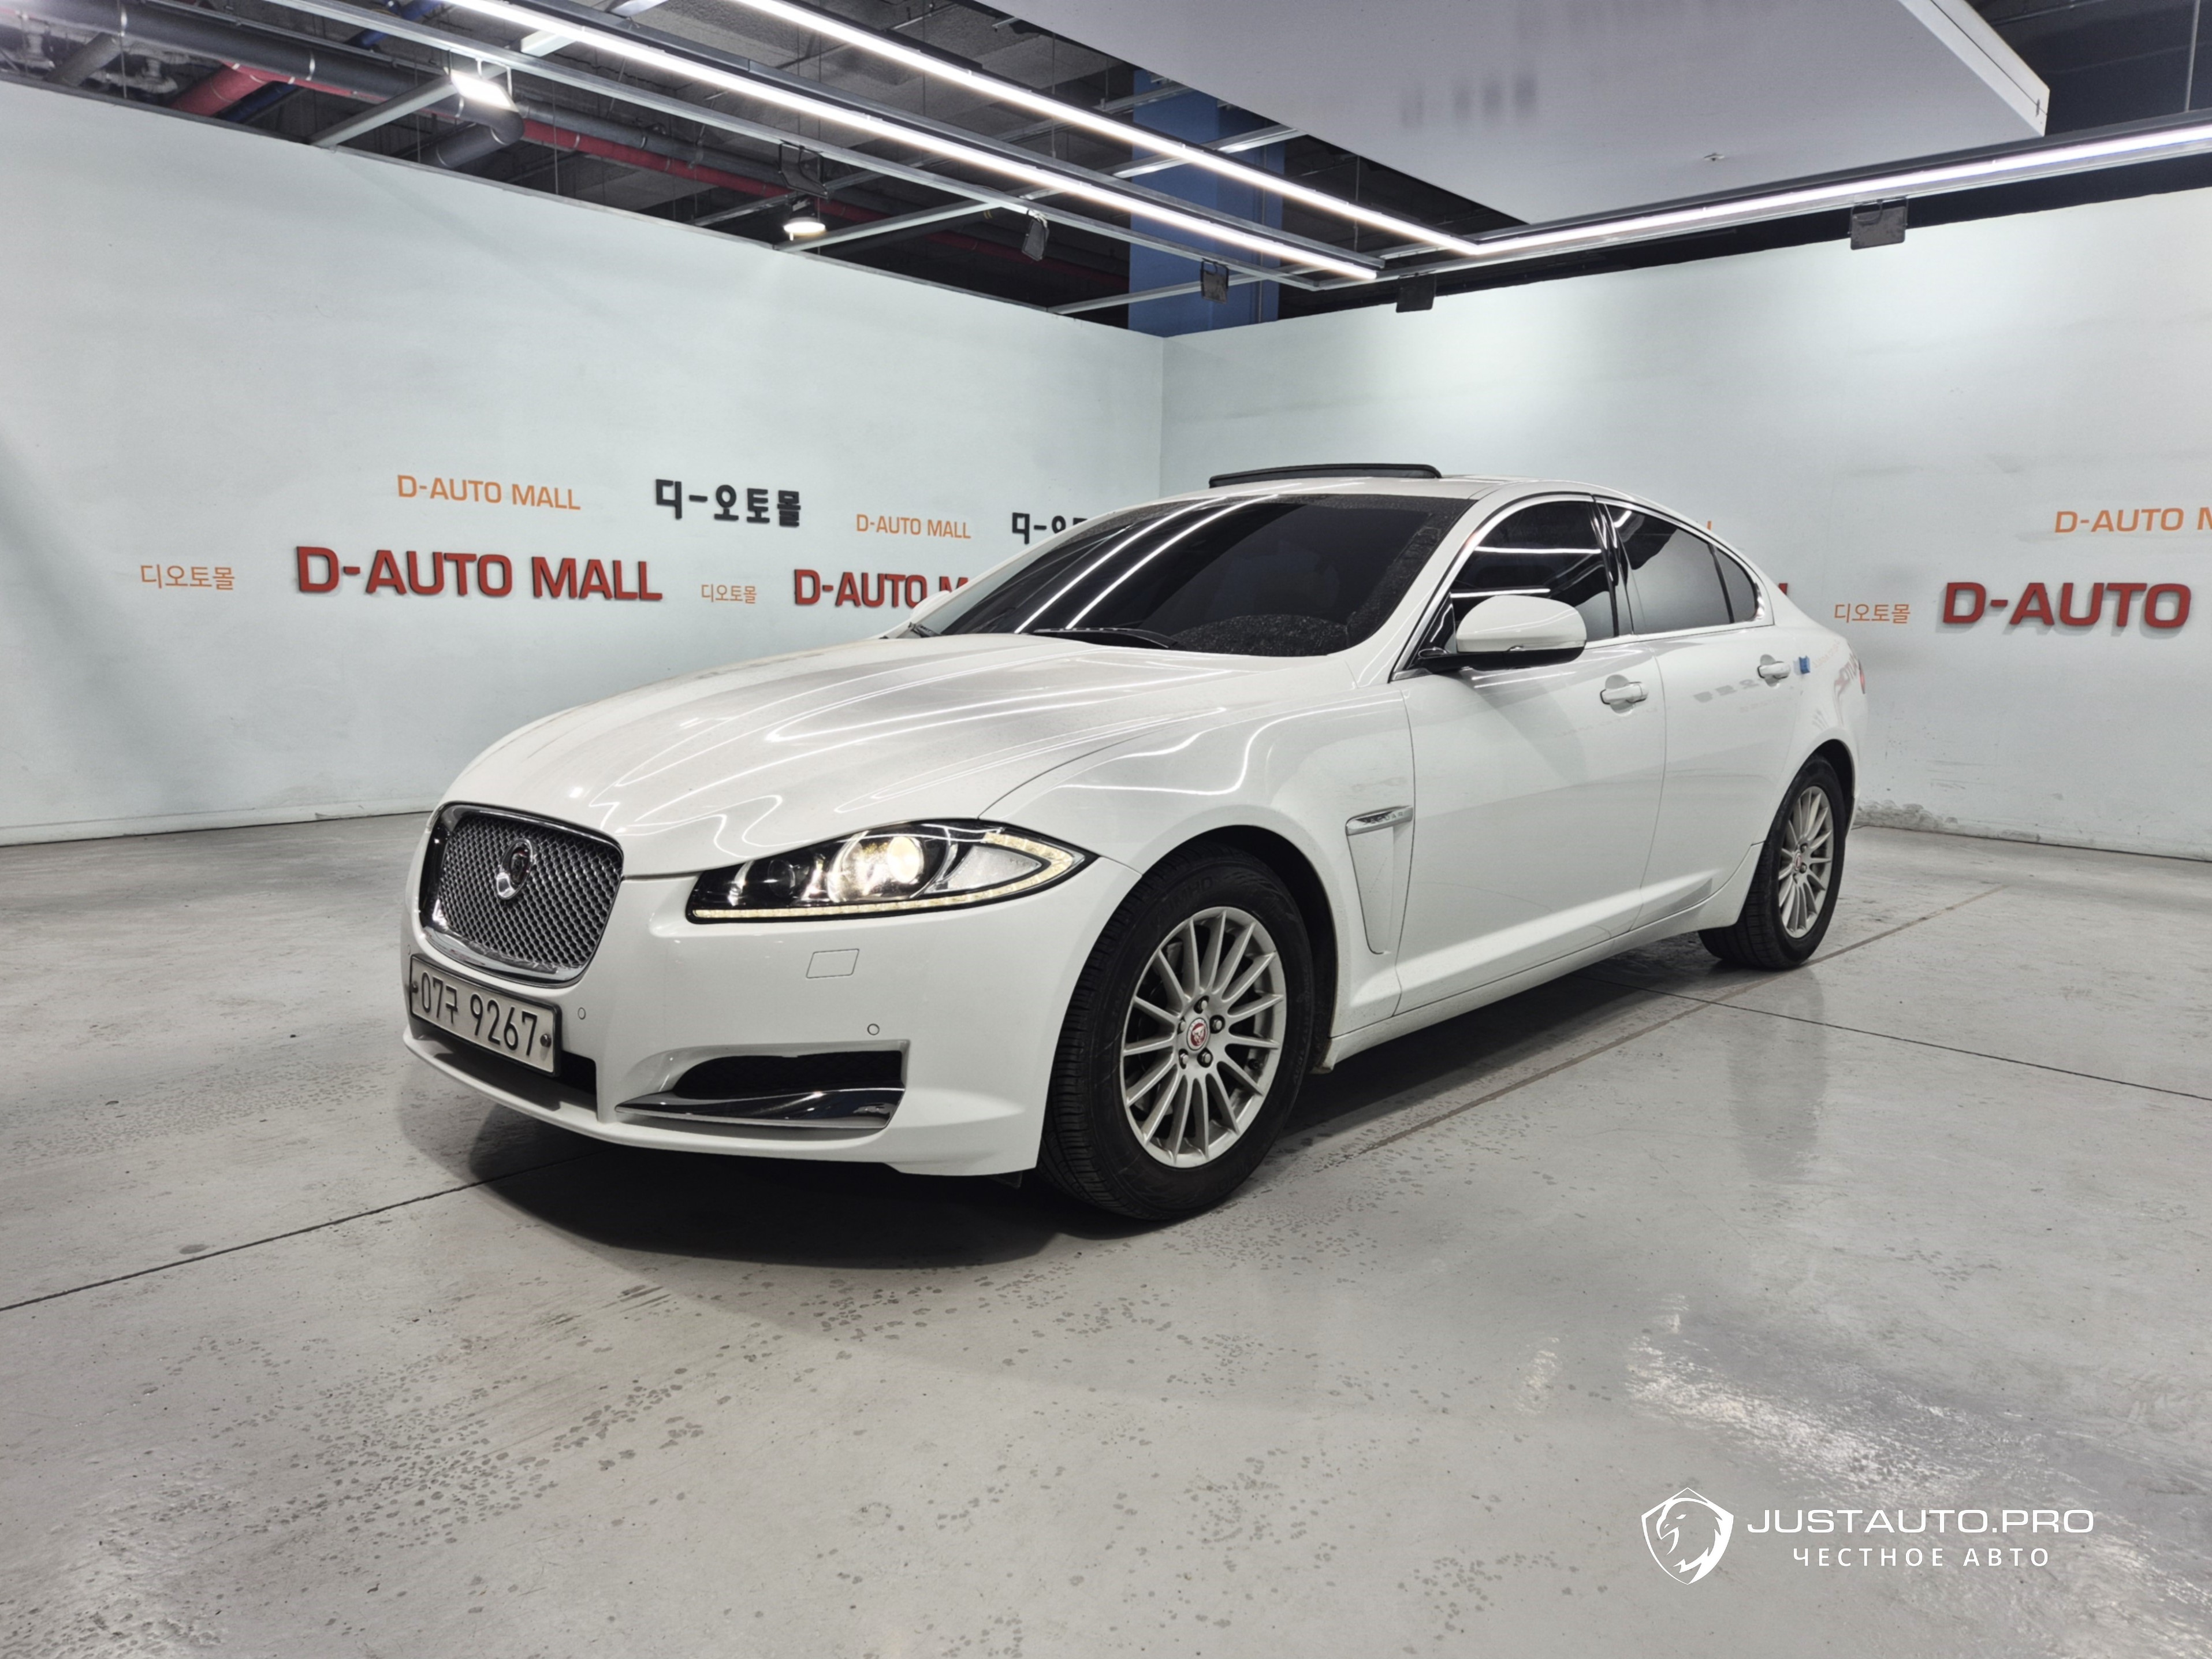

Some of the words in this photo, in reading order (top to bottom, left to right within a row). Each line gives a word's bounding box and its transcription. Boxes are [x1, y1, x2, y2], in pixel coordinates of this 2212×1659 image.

[397, 474, 503, 504] D-AUTO
[511, 483, 582, 511] MALL
[655, 478, 802, 528] 디-오토몰
[856, 513, 923, 535] D-AUTO
[927, 519, 971, 540] MALL
[2054, 507, 2185, 533] D-AUTO
[140, 564, 235, 590] 디오토몰
[296, 545, 513, 597] D-AUTO
[531, 556, 663, 600] MALL
[794, 569, 928, 609] D-AUTO
[700, 583, 758, 605] 디오토몰
[1943, 582, 2191, 628] D-AUTO
[1834, 602, 1911, 624] 디오토몰
[422, 972, 459, 1024] 07구
[470, 994, 537, 1056] 9267
